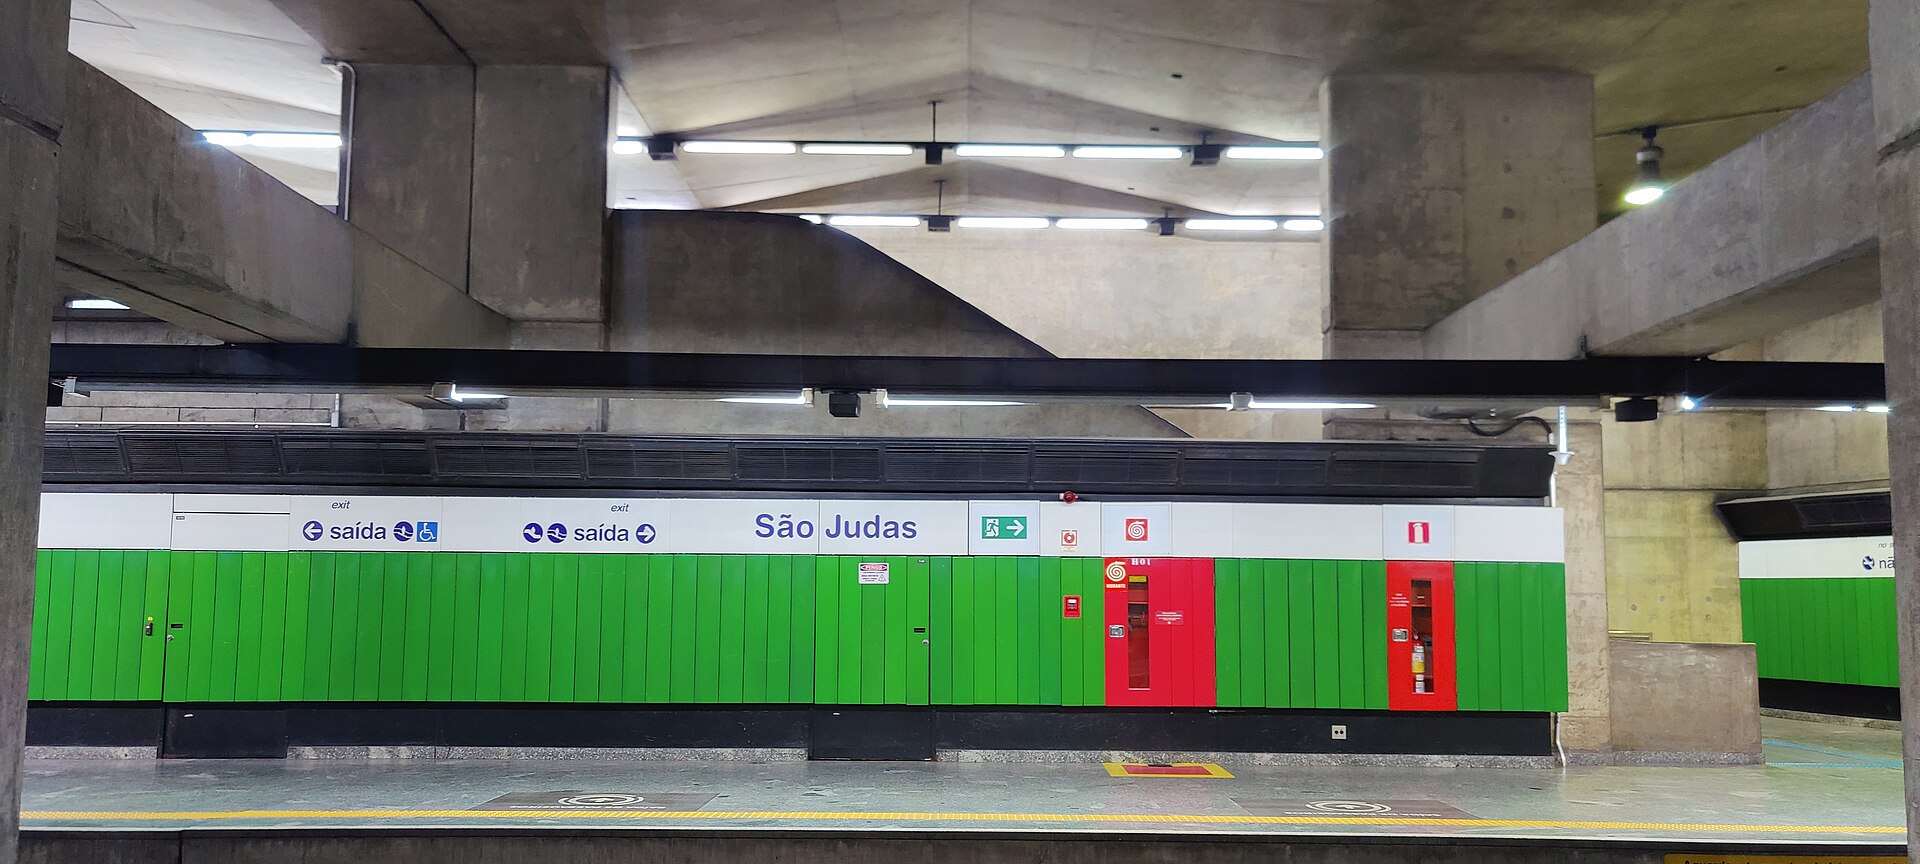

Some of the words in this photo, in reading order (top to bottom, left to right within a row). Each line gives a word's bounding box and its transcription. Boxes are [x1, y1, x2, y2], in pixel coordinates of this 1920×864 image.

[331, 499, 351, 510] exit
[610, 502, 630, 513] exit
[329, 521, 387, 541] saída
[573, 523, 630, 543] saída
[755, 513, 814, 539] São
[825, 513, 917, 539] Judas
